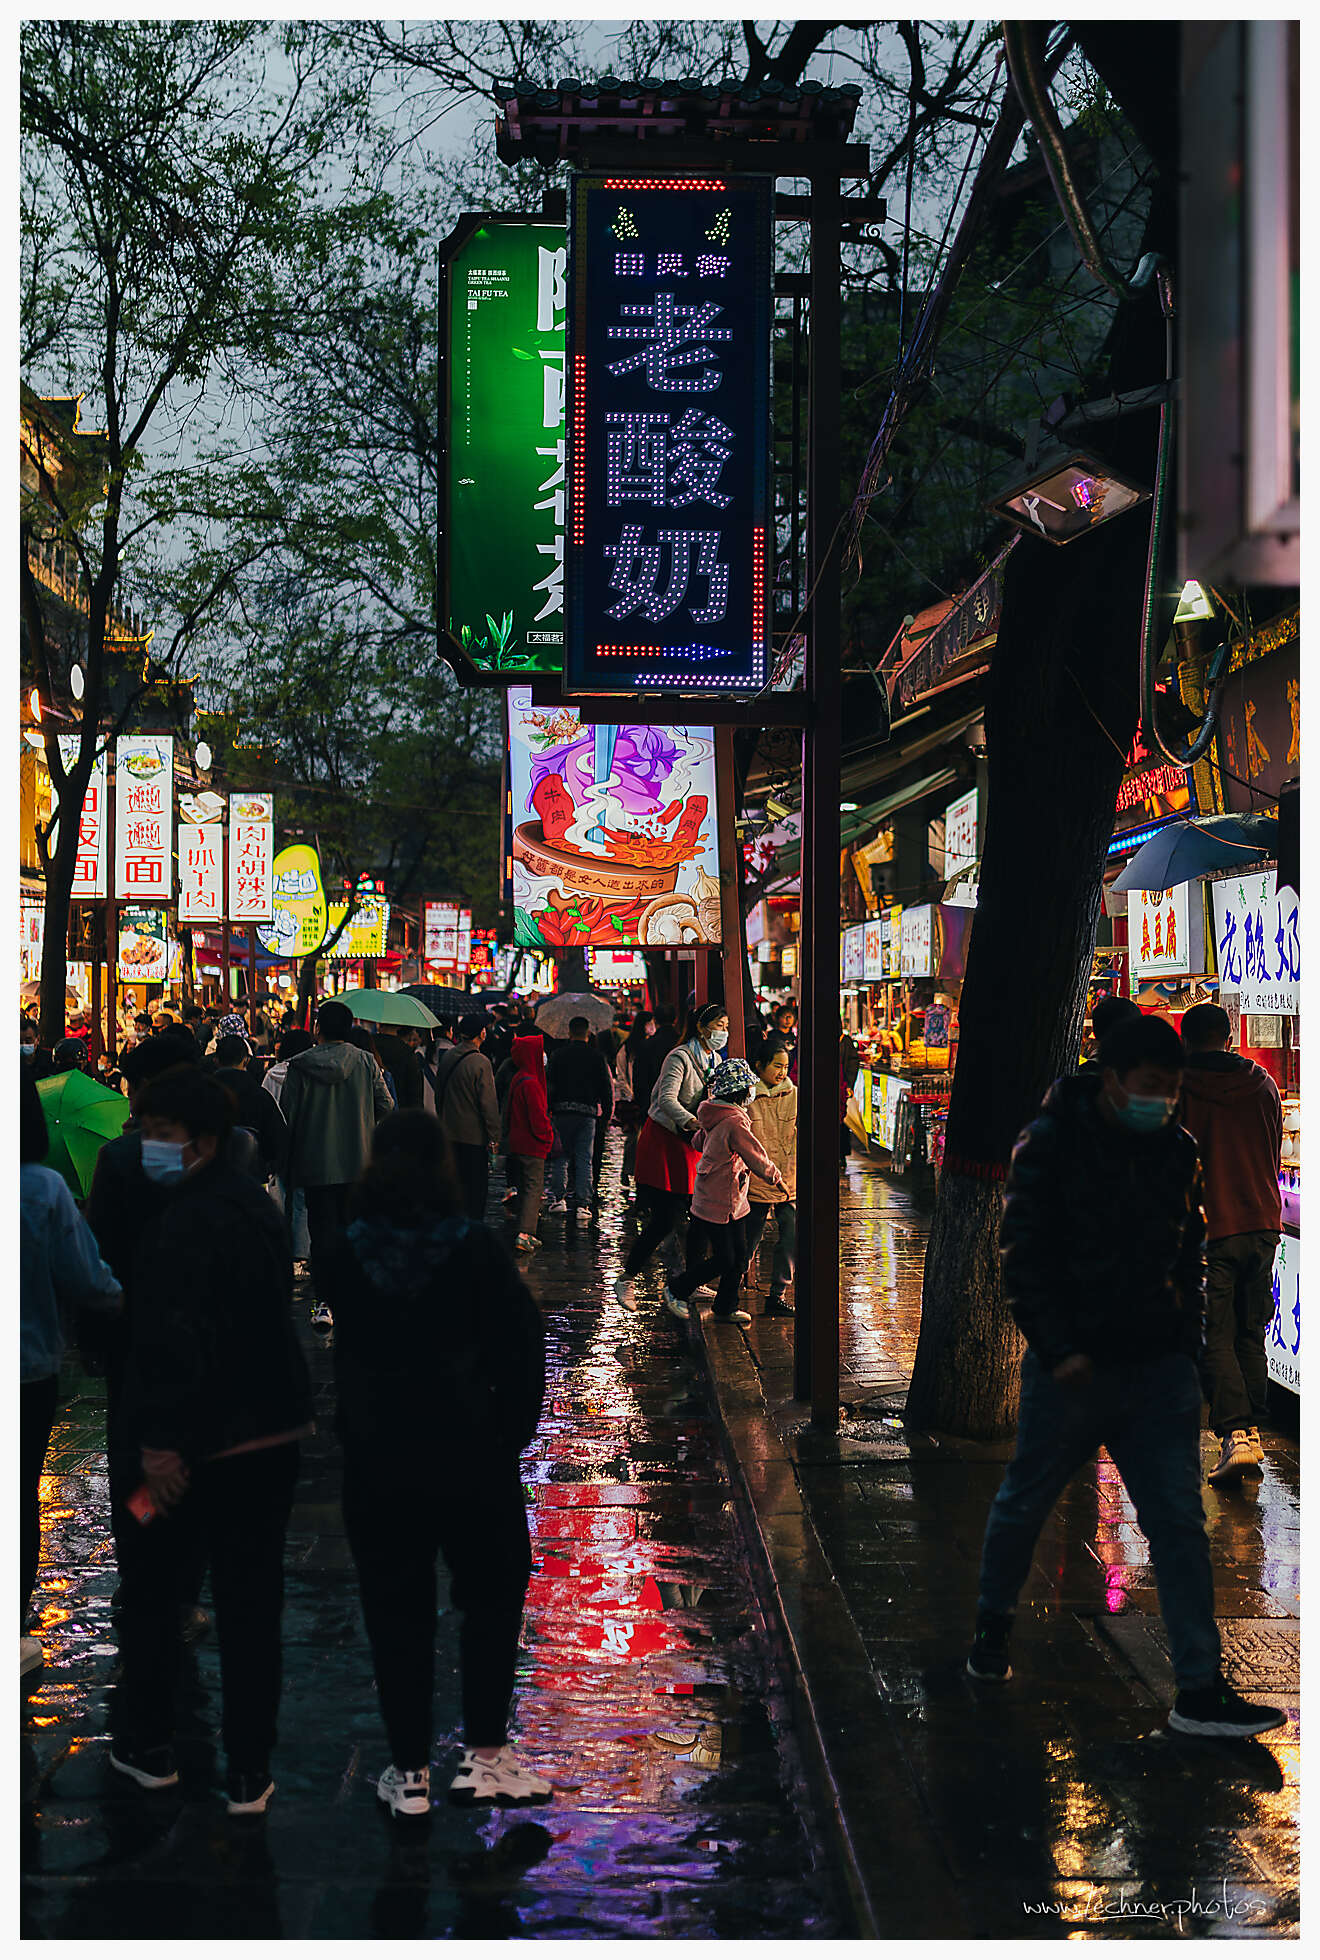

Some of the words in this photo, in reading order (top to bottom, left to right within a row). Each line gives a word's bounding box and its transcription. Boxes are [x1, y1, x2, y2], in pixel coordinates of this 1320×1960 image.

[467, 289, 481, 297] TAI
[481, 289, 493, 297] FU
[603, 291, 736, 625] 老酸奶
[543, 788, 566, 824] 牛肉
[682, 803, 703, 831] 牛肉
[236, 825, 266, 909] 肉丸胡辣汤
[1140, 905, 1177, 962] 臭豆腐
[1219, 900, 1301, 985] 老酸奶
